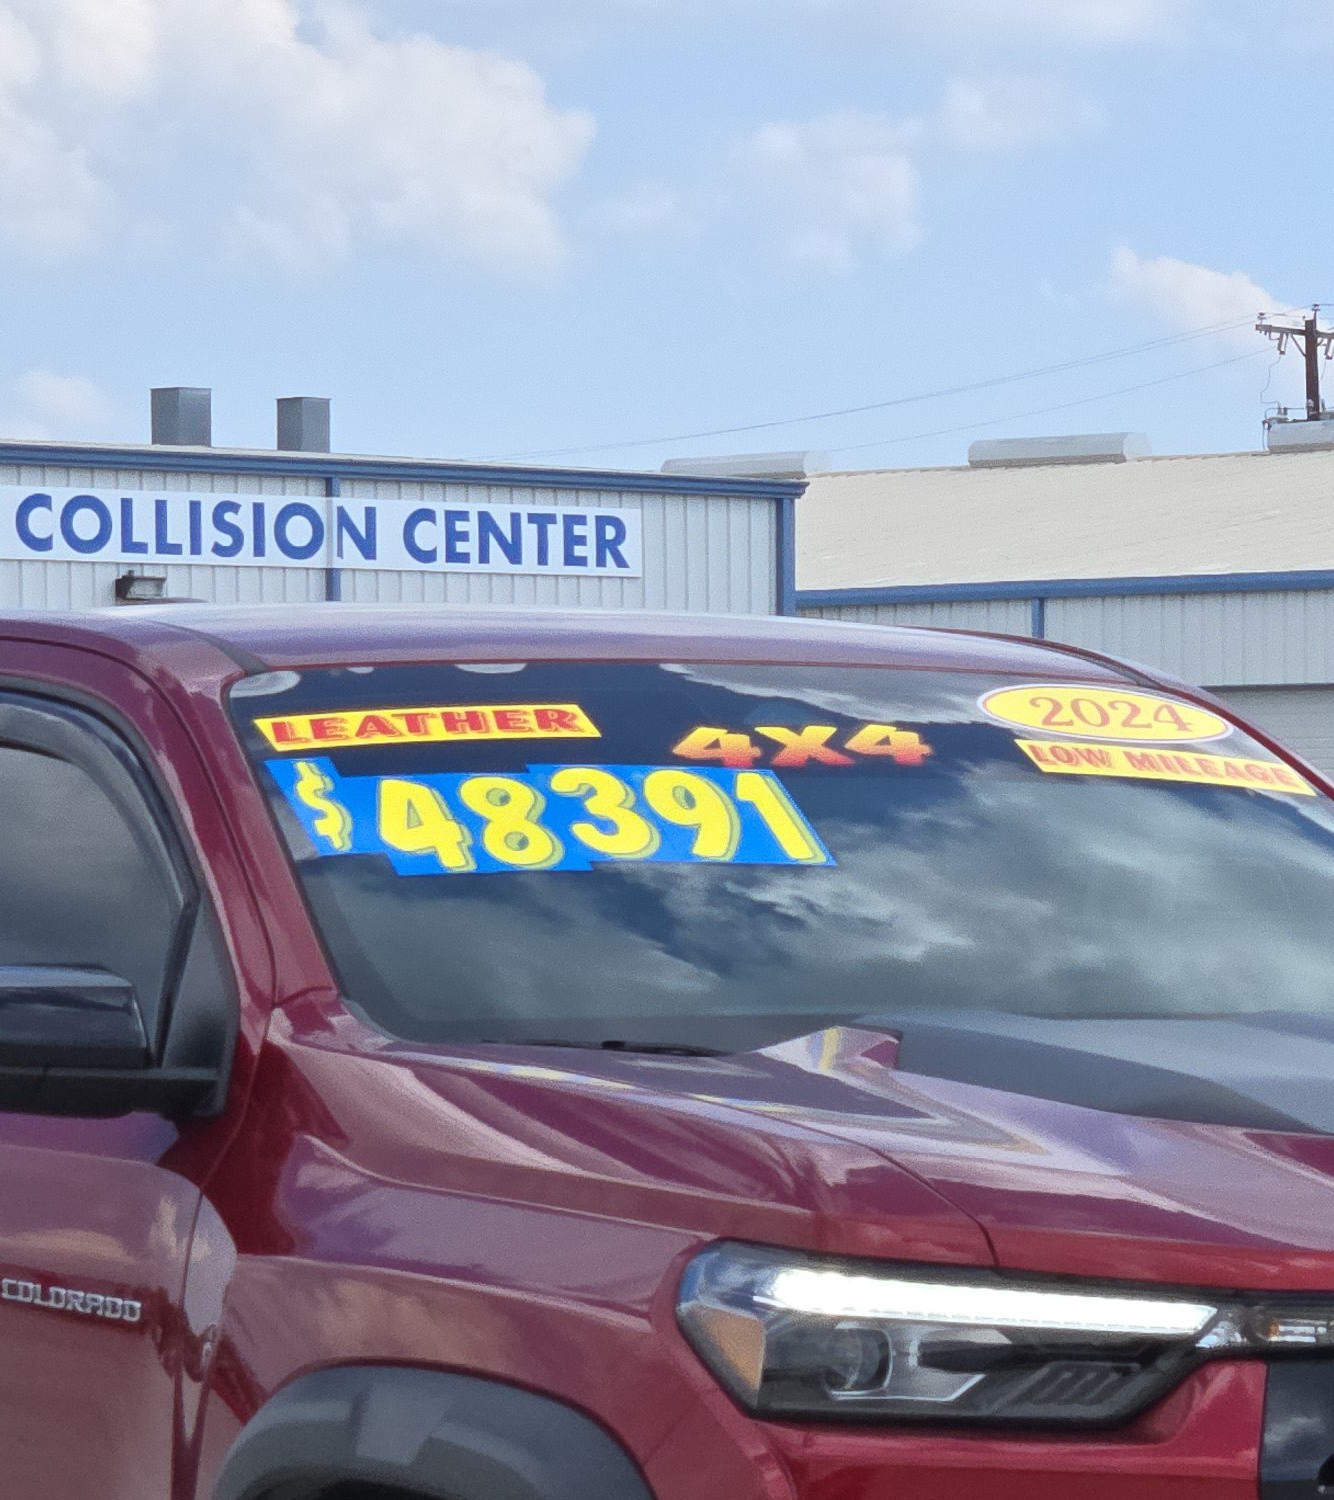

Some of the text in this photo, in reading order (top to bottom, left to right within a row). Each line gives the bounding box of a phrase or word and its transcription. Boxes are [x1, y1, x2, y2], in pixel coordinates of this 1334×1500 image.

[15, 492, 630, 568] COLLISION CENTER
[271, 708, 584, 744] LEATHER
[1032, 697, 1192, 732] 2024
[1028, 745, 1299, 786] LOW MILEAGE
[1, 1278, 141, 1321] COLORADO
